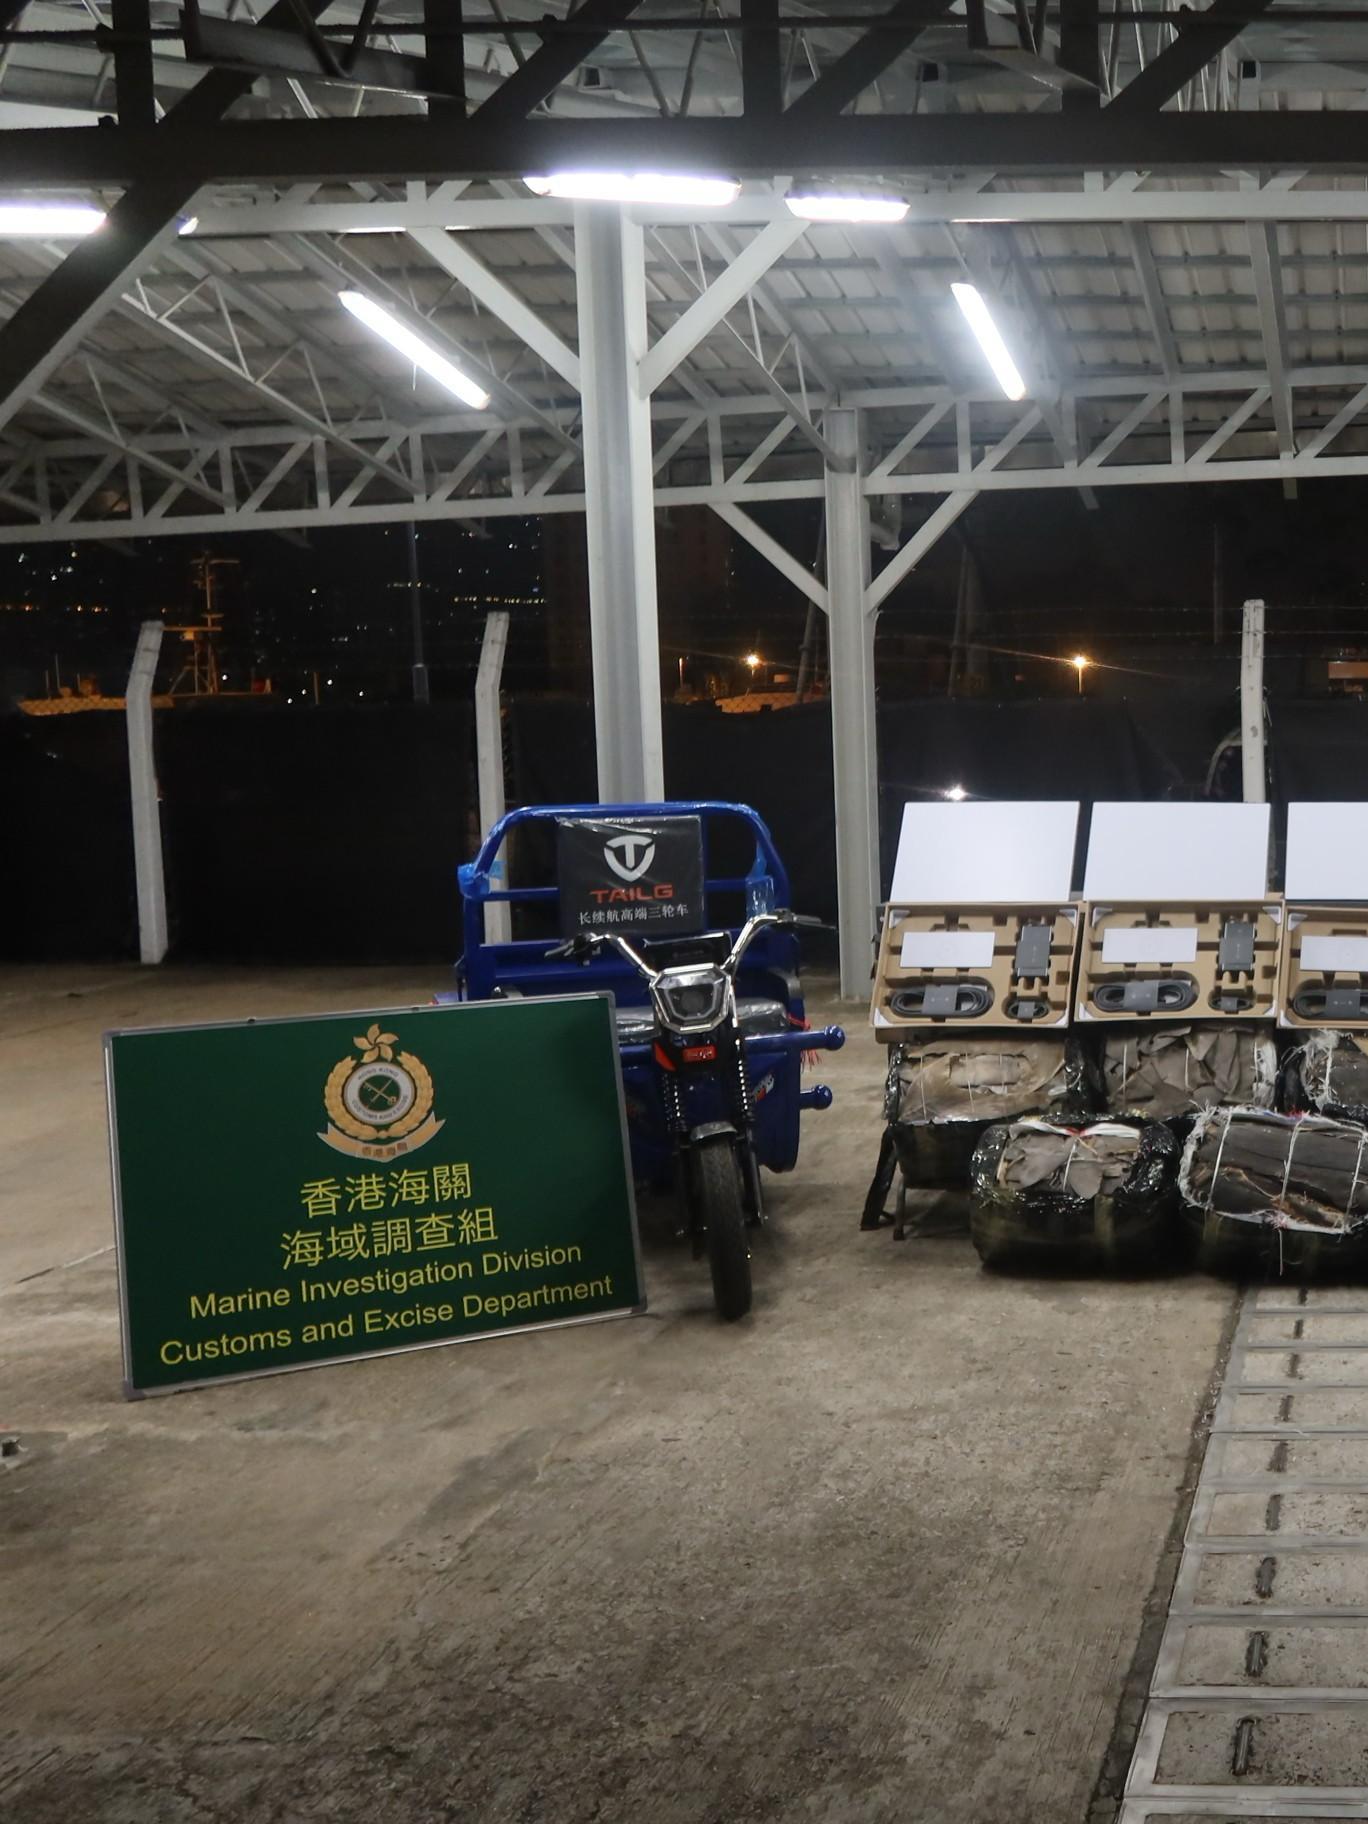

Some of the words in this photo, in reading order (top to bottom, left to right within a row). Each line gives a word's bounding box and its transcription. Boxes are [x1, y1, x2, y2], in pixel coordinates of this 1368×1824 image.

[578, 903, 689, 925] 长续航高端三轮车
[590, 884, 674, 904] TAILG
[300, 1163, 472, 1218] 香港海關
[280, 1207, 498, 1269] 海域調查組
[190, 1288, 291, 1318] Marine
[301, 1262, 474, 1300] Investigation
[483, 1245, 582, 1275] Division
[160, 1329, 292, 1365] Customs
[303, 1316, 354, 1342] and
[364, 1305, 455, 1333] Excise
[463, 1278, 613, 1316] Department
